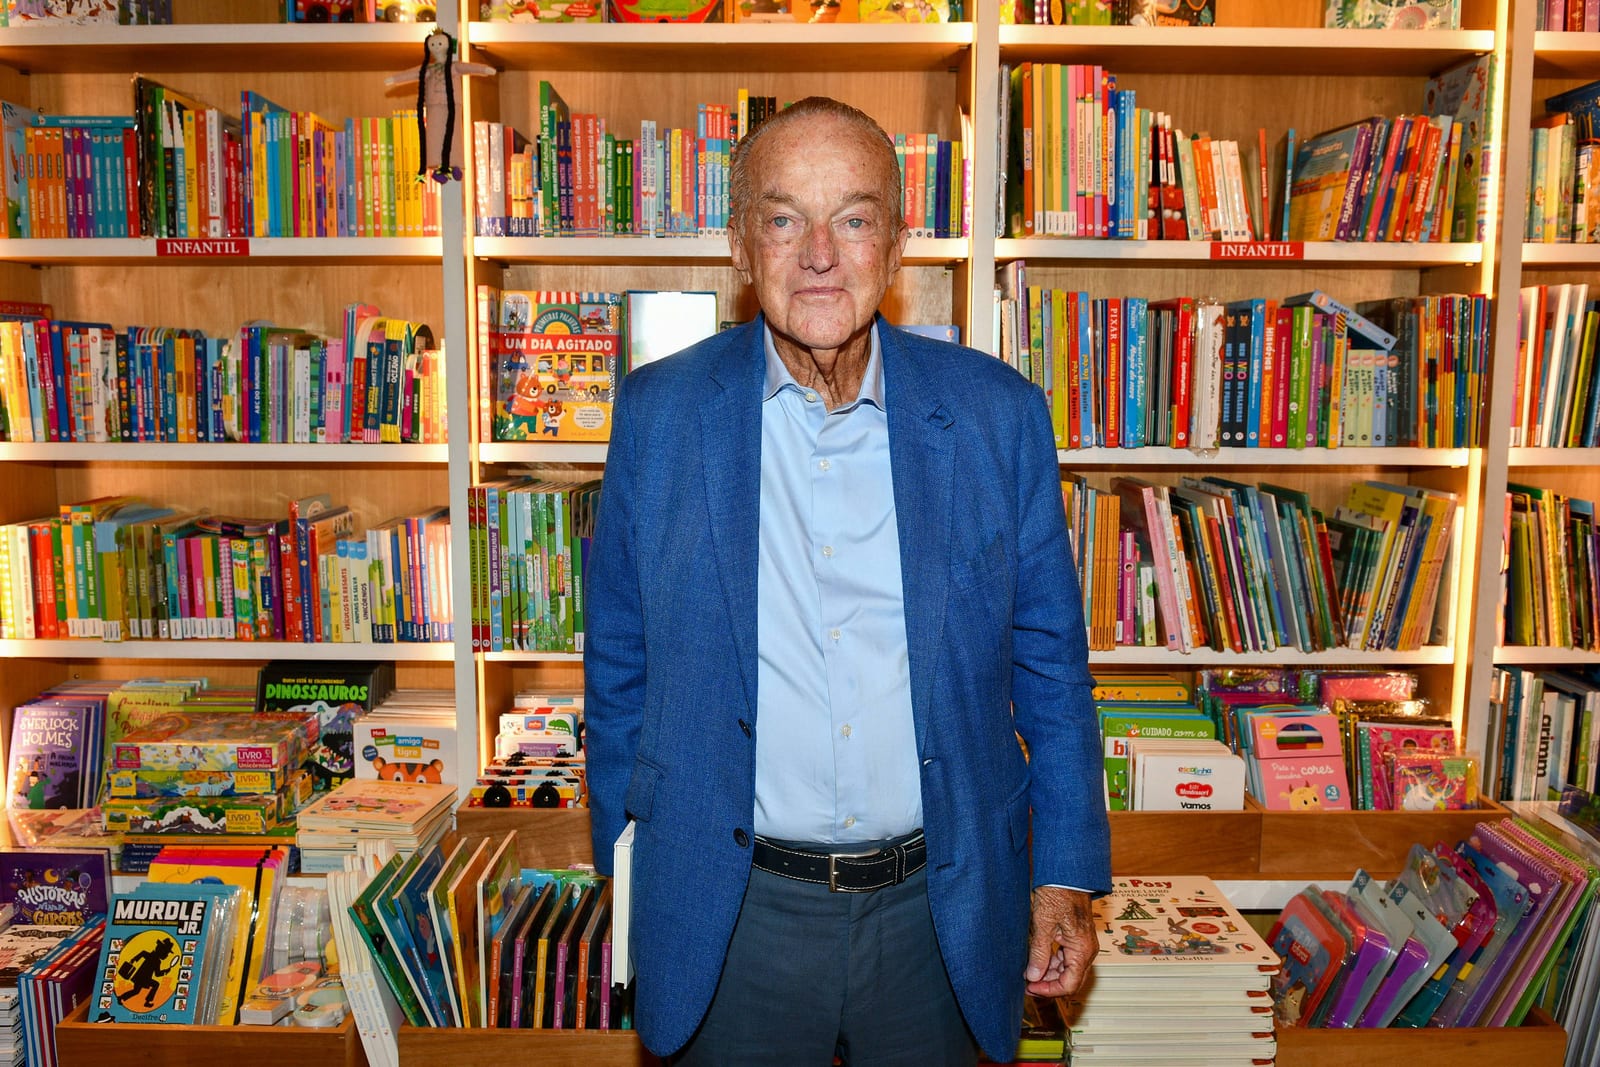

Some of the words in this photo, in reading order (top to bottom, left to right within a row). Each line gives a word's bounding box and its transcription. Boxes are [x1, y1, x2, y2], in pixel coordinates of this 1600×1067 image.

[166, 242, 240, 254] INFANTIL
[1220, 244, 1294, 258] INFANTIL
[533, 312, 559, 333] PRIMEIRAS
[1110, 308, 1118, 340] PIXAR
[505, 338, 527, 350] UM
[1264, 327, 1275, 370] Histórias
[360, 583, 368, 620] UNICÓRNIOS
[264, 683, 367, 701] DINOSSAUROS
[20, 716, 79, 732] SHERLOCK
[1141, 726, 1172, 737] CUIDADO
[22, 732, 72, 748] HOLMES
[397, 737, 420, 746] amigo
[238, 750, 262, 760] LIVRO
[397, 746, 418, 756] tigre
[1300, 764, 1335, 776] cores
[236, 774, 260, 782] LIVRO
[1180, 802, 1212, 810] Vamos
[226, 814, 250, 822] LIVRO
[1129, 879, 1172, 889] Posy
[17, 884, 87, 909] HISTÓRIAS
[114, 900, 204, 920] MURDLE
[178, 921, 200, 934] JR.
